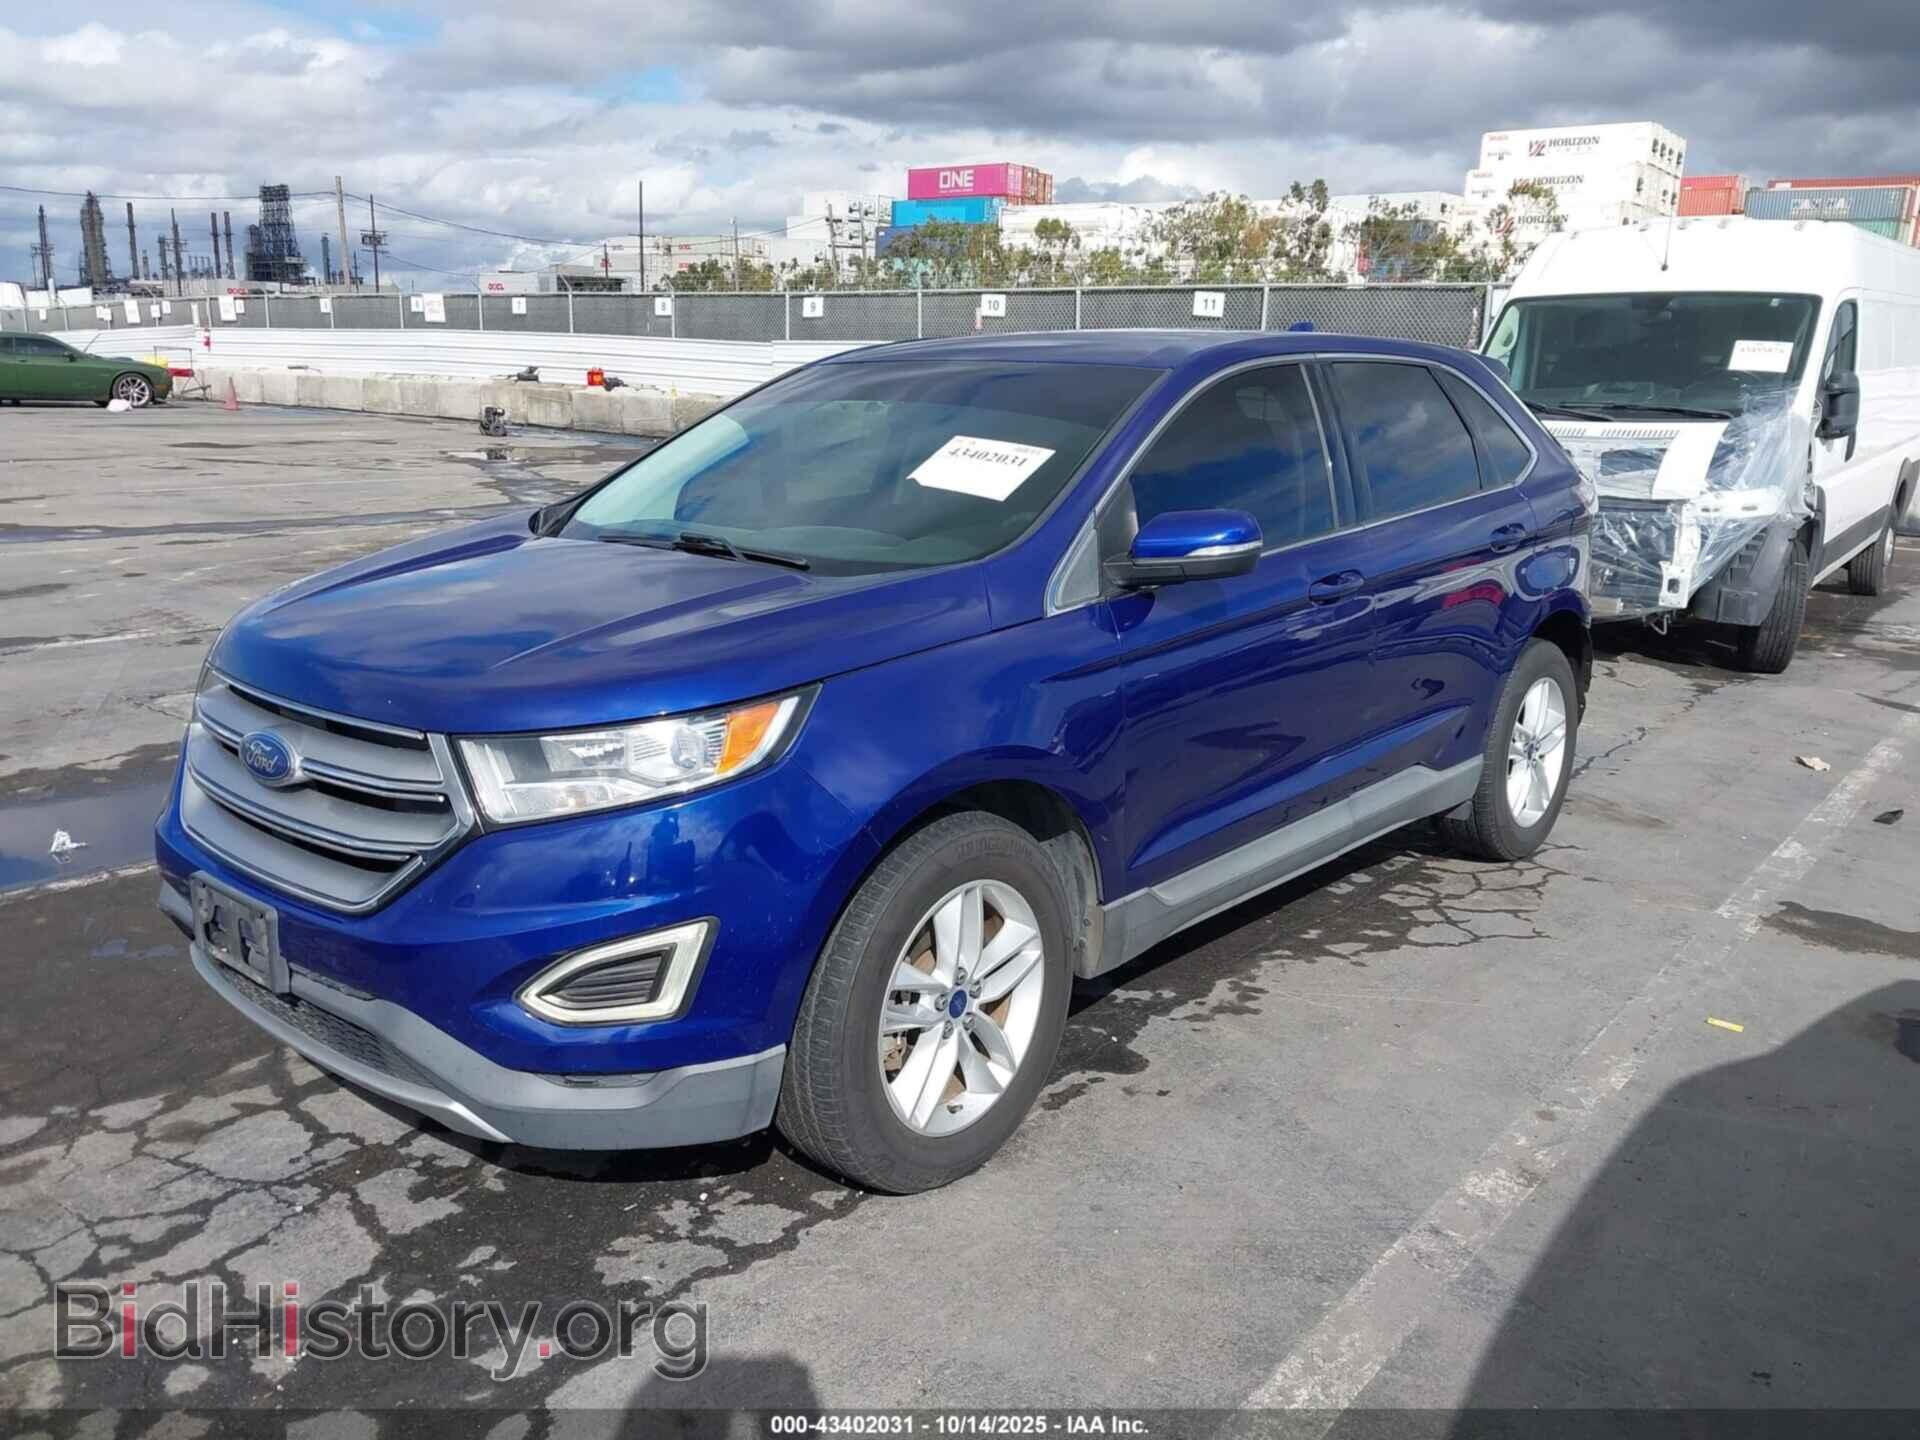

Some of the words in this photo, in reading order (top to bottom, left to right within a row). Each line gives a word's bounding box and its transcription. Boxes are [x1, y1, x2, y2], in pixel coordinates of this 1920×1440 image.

[1548, 136, 1600, 147] HORIZON
[939, 169, 975, 189] ONE
[810, 301, 816, 312] 9
[987, 299, 999, 311] 10
[1203, 298, 1216, 311] 11
[246, 739, 277, 773] Ford
